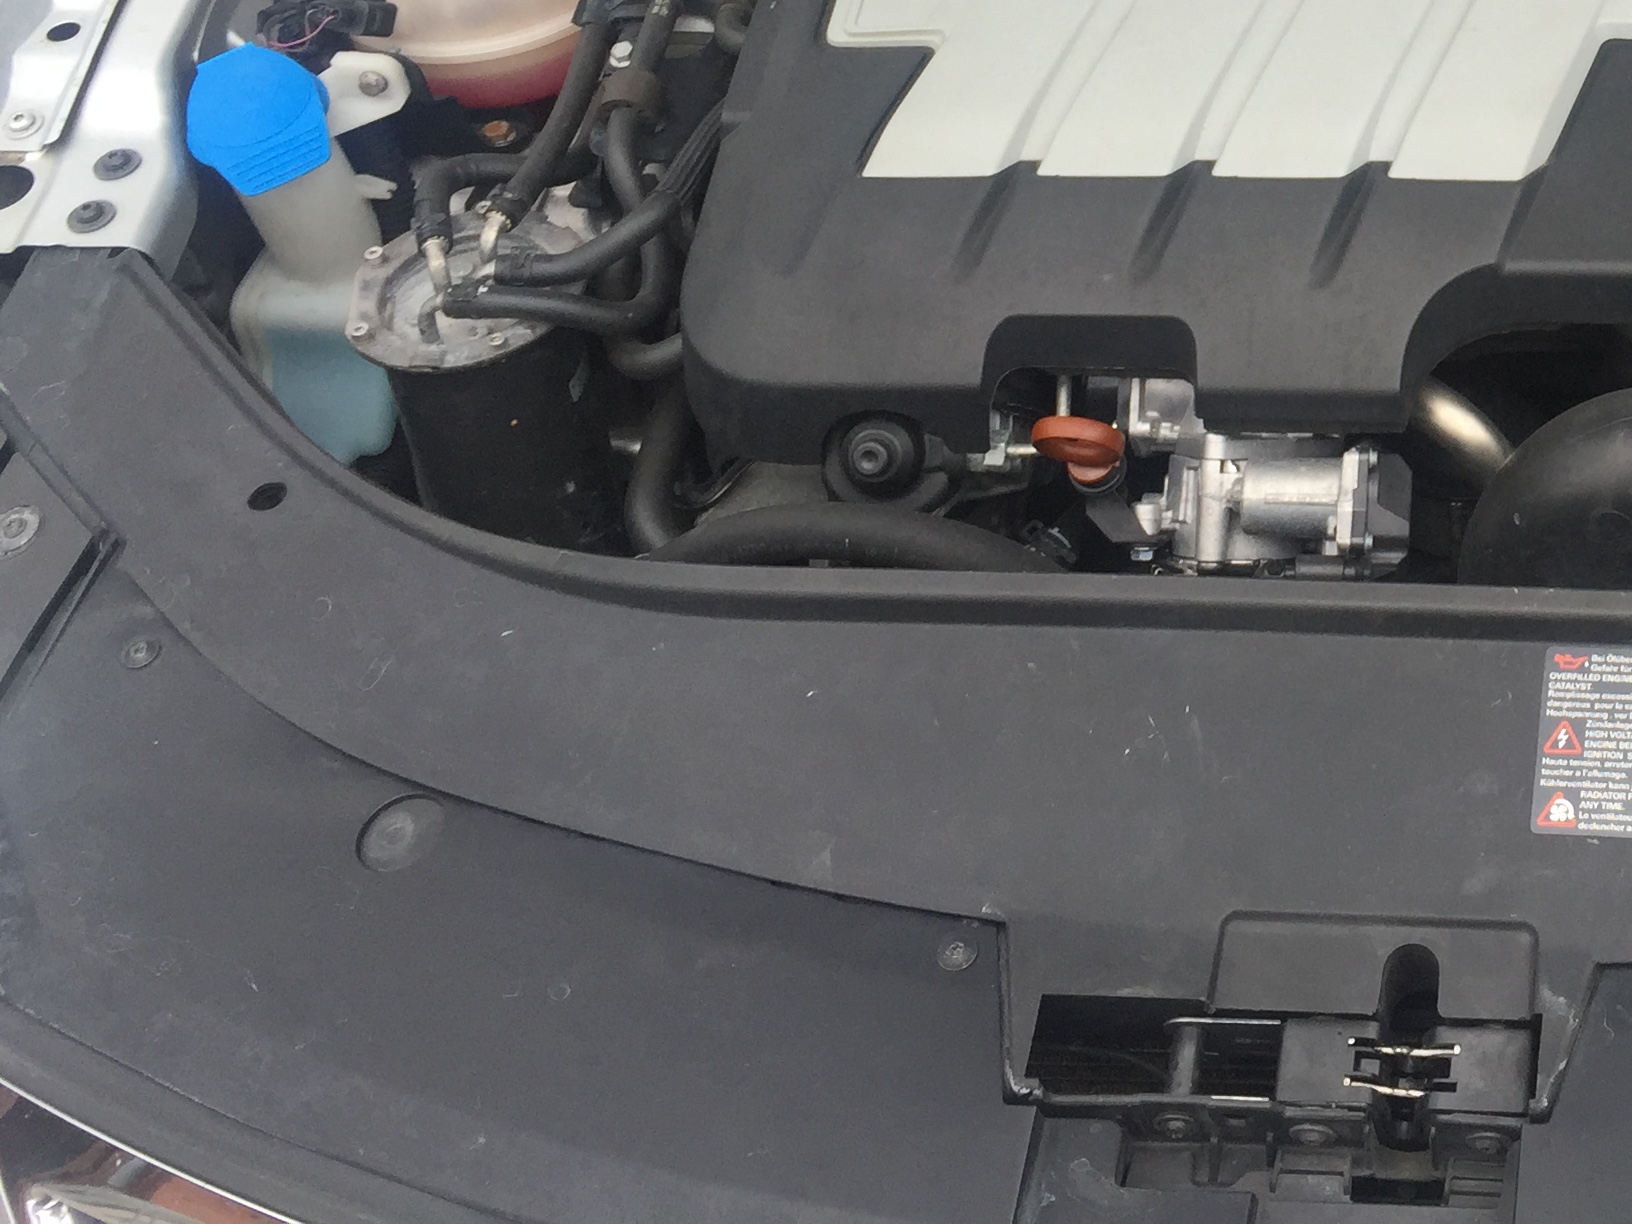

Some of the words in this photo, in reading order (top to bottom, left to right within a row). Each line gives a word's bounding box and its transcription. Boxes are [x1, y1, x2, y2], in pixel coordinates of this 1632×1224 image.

[1549, 672, 1601, 682] OVERFILLED
[1585, 730, 1608, 739] HIGH
[1585, 740, 1617, 749] ENGINE
[1584, 750, 1623, 760] IGNITION
[1542, 757, 1568, 766] Haute
[1541, 767, 1574, 776] toucher
[1609, 781, 1630, 789] kann
[1580, 791, 1626, 800] RADIATOR
[1579, 801, 1600, 809] ANY
